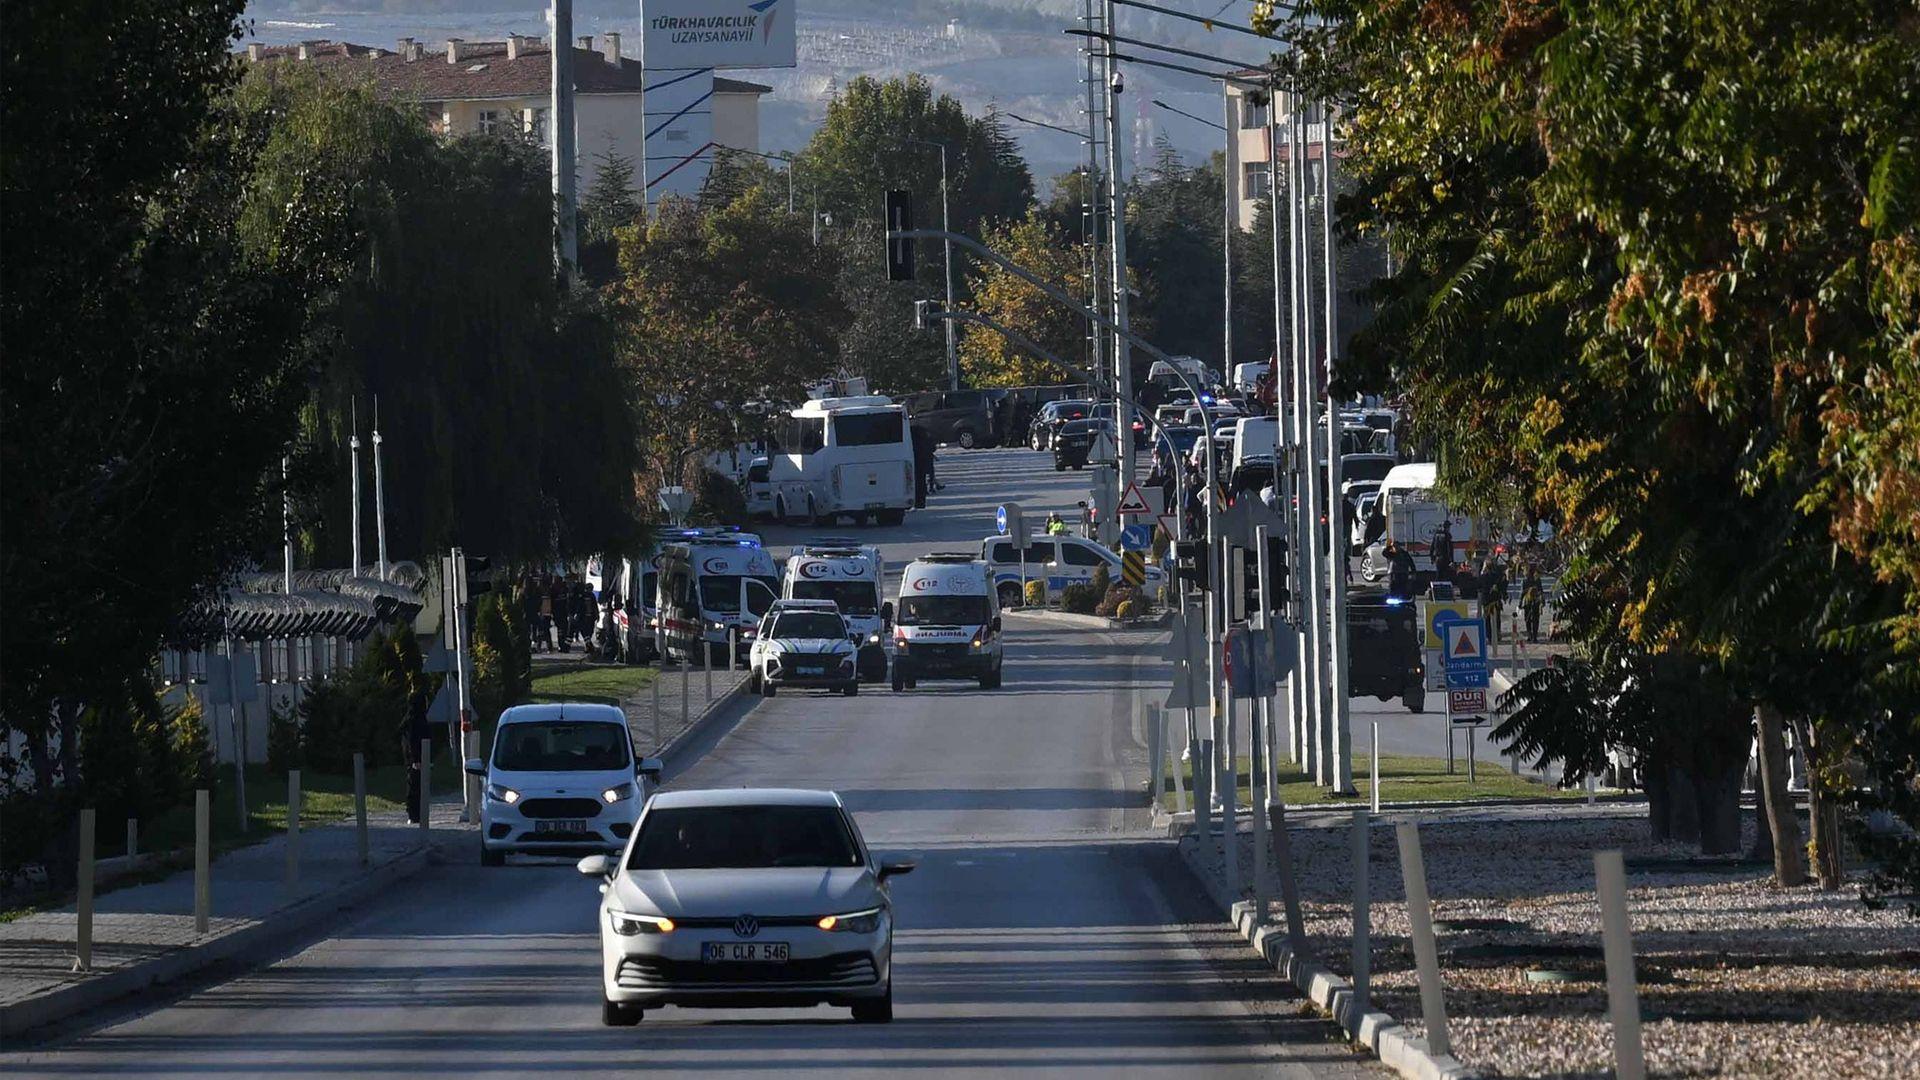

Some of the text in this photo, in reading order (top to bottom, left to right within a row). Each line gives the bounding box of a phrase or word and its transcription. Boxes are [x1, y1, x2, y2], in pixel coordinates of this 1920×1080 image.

[1465, 674, 1479, 682] 112
[1453, 692, 1482, 701] DUR
[710, 944, 787, 959] 06 CLR 546
